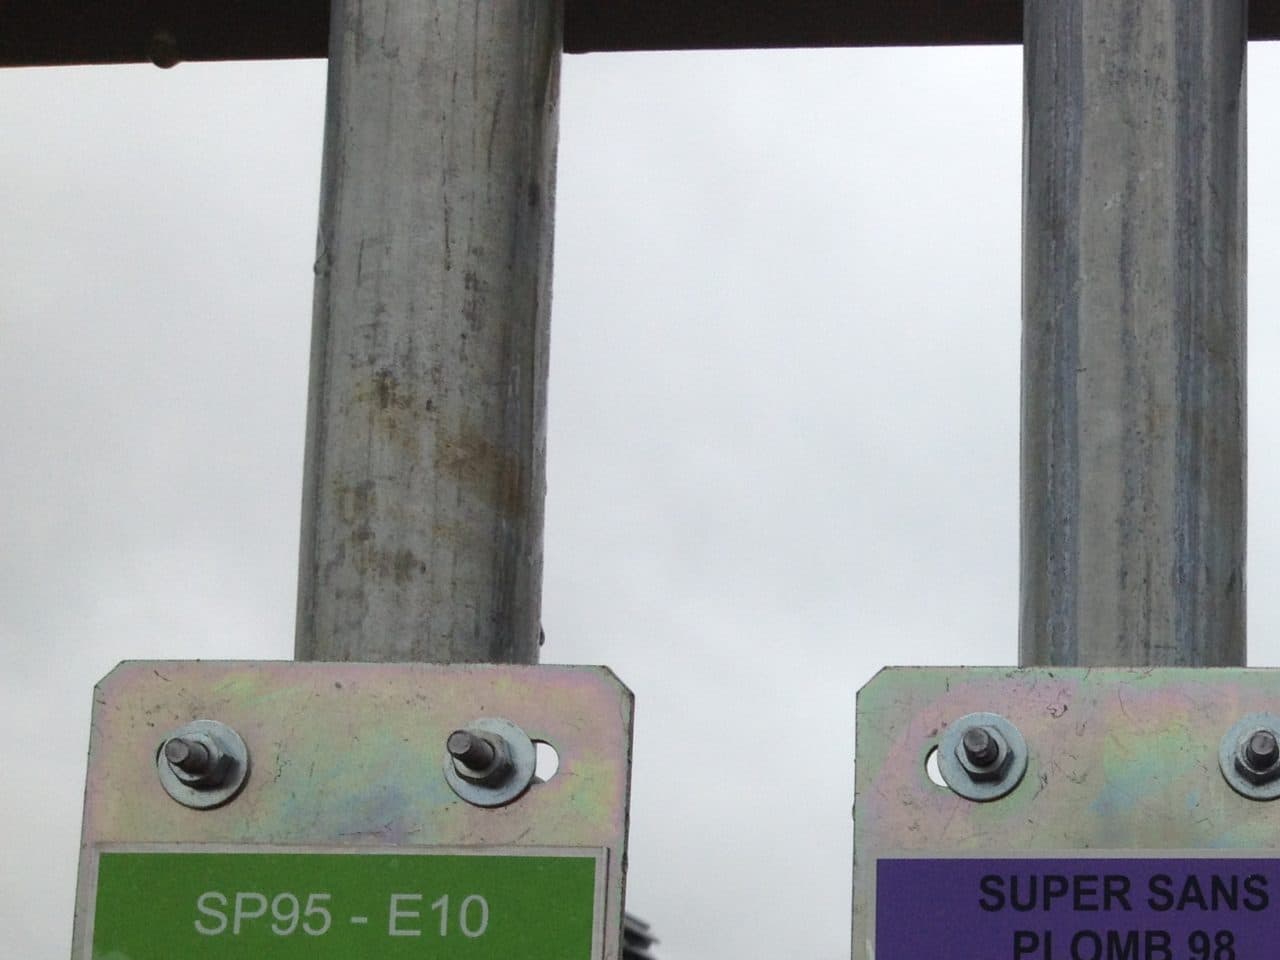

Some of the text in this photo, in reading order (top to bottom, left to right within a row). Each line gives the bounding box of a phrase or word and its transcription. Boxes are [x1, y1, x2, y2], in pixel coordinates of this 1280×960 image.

[194, 890, 332, 937] SP95
[388, 893, 490, 938] E10
[978, 874, 1270, 912] SUPER SANS
